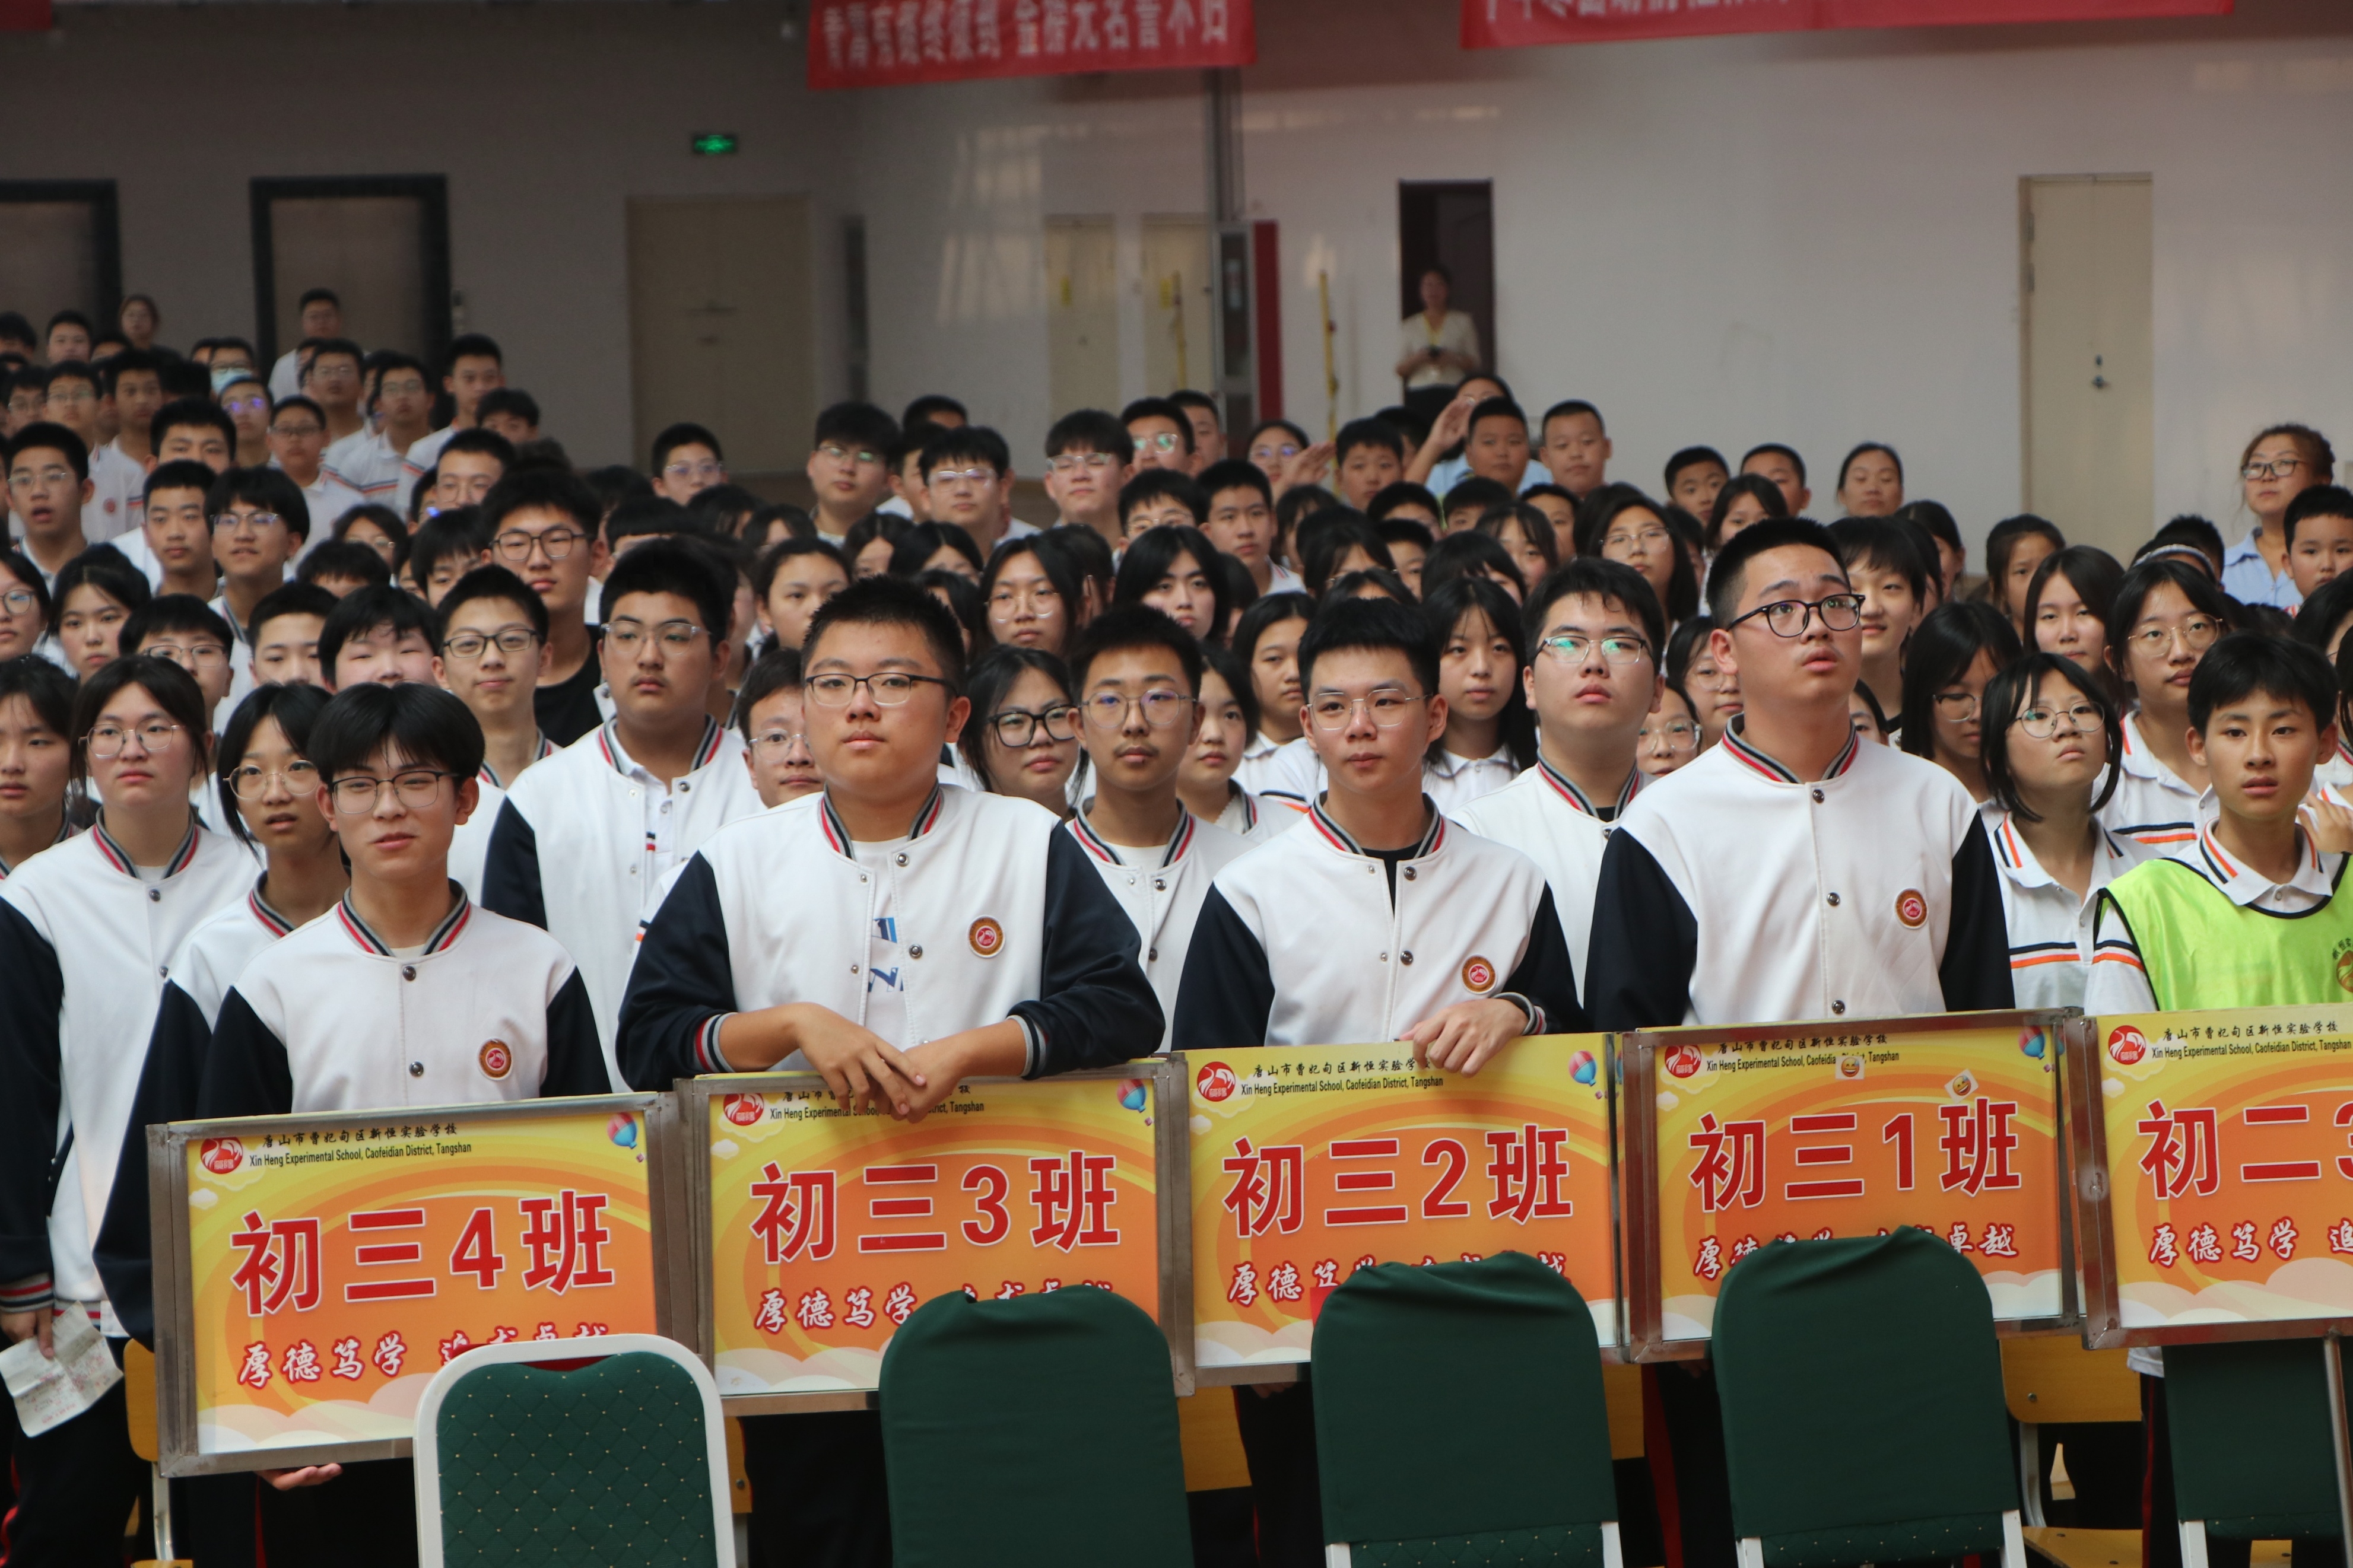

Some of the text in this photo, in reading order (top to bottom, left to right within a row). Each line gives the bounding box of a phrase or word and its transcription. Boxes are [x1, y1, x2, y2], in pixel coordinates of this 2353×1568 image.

[2163, 1020, 2338, 1041] 唐山市曹妃甸区新恒实验学校
[1707, 1060, 1717, 1071] Xin
[1719, 1059, 1735, 1072] Heng
[1738, 1056, 1779, 1071] Experimental
[1781, 1055, 1805, 1067] School,
[1806, 1054, 1836, 1066] Caofeidia
[1869, 1051, 1899, 1064] Tangshan
[2152, 1047, 2163, 1058] Xin
[2165, 1047, 2182, 1059] Heng
[2184, 1044, 2227, 1058] Experimental
[2229, 1043, 2253, 1055] School,
[2255, 1041, 2290, 1054] Caofeidian
[2291, 1040, 2317, 1052] District,
[2319, 1039, 2351, 1051] Tangshan
[1241, 1084, 1252, 1095] Xin
[1255, 1083, 1271, 1096] Heng
[1274, 1080, 1317, 1095] Experimental
[1319, 1079, 1344, 1092] School,
[1346, 1077, 1381, 1090] Caofeidian
[1383, 1076, 1409, 1089] District,
[1411, 1076, 1443, 1089] Tangshan
[770, 1108, 782, 1119] Xin
[785, 1107, 802, 1120] Heng
[950, 1101, 984, 1115] Tangshan
[263, 1122, 458, 1148] 唐山市曹妃甸区新恒实验学校
[250, 1154, 262, 1166] Xin
[264, 1153, 283, 1167] Heng
[285, 1149, 334, 1165] Experimental
[336, 1148, 363, 1161] School,
[366, 1145, 404, 1159] Caofeidian
[406, 1144, 434, 1156] District,
[436, 1143, 471, 1156] Tangshan
[1688, 1096, 2022, 1213] 初三1班
[1222, 1124, 1573, 1238] 初三2班
[750, 1150, 1121, 1265] 初三3班
[229, 1188, 617, 1317] 初三4班
[2148, 1217, 2299, 1268] 厚德笃学
[239, 1331, 408, 1388] 厚德笃学
